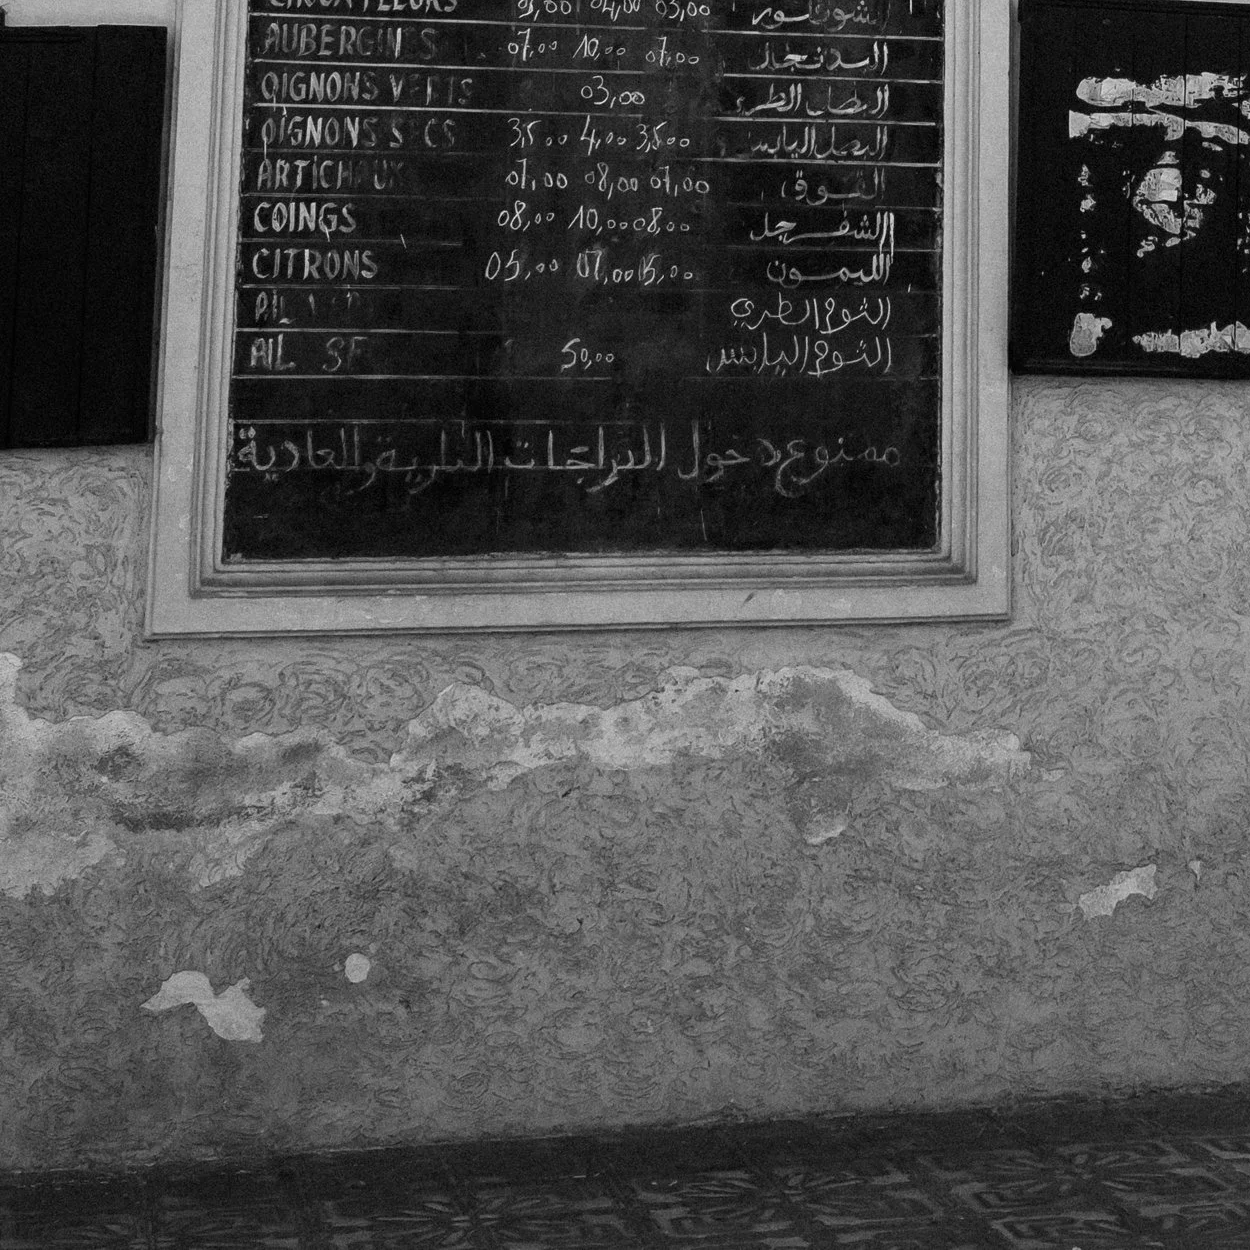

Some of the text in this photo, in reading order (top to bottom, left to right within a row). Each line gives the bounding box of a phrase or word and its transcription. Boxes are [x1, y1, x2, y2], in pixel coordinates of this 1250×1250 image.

[572, 34, 626, 61] 10,00
[261, 71, 379, 106] OIGNONS
[581, 75, 646, 109] 03,00
[261, 114, 379, 148] OIGNONS
[254, 201, 357, 239] COINGS
[498, 201, 555, 232] 08,00
[252, 248, 379, 280] CITRONS
[485, 249, 559, 282] 05,00
